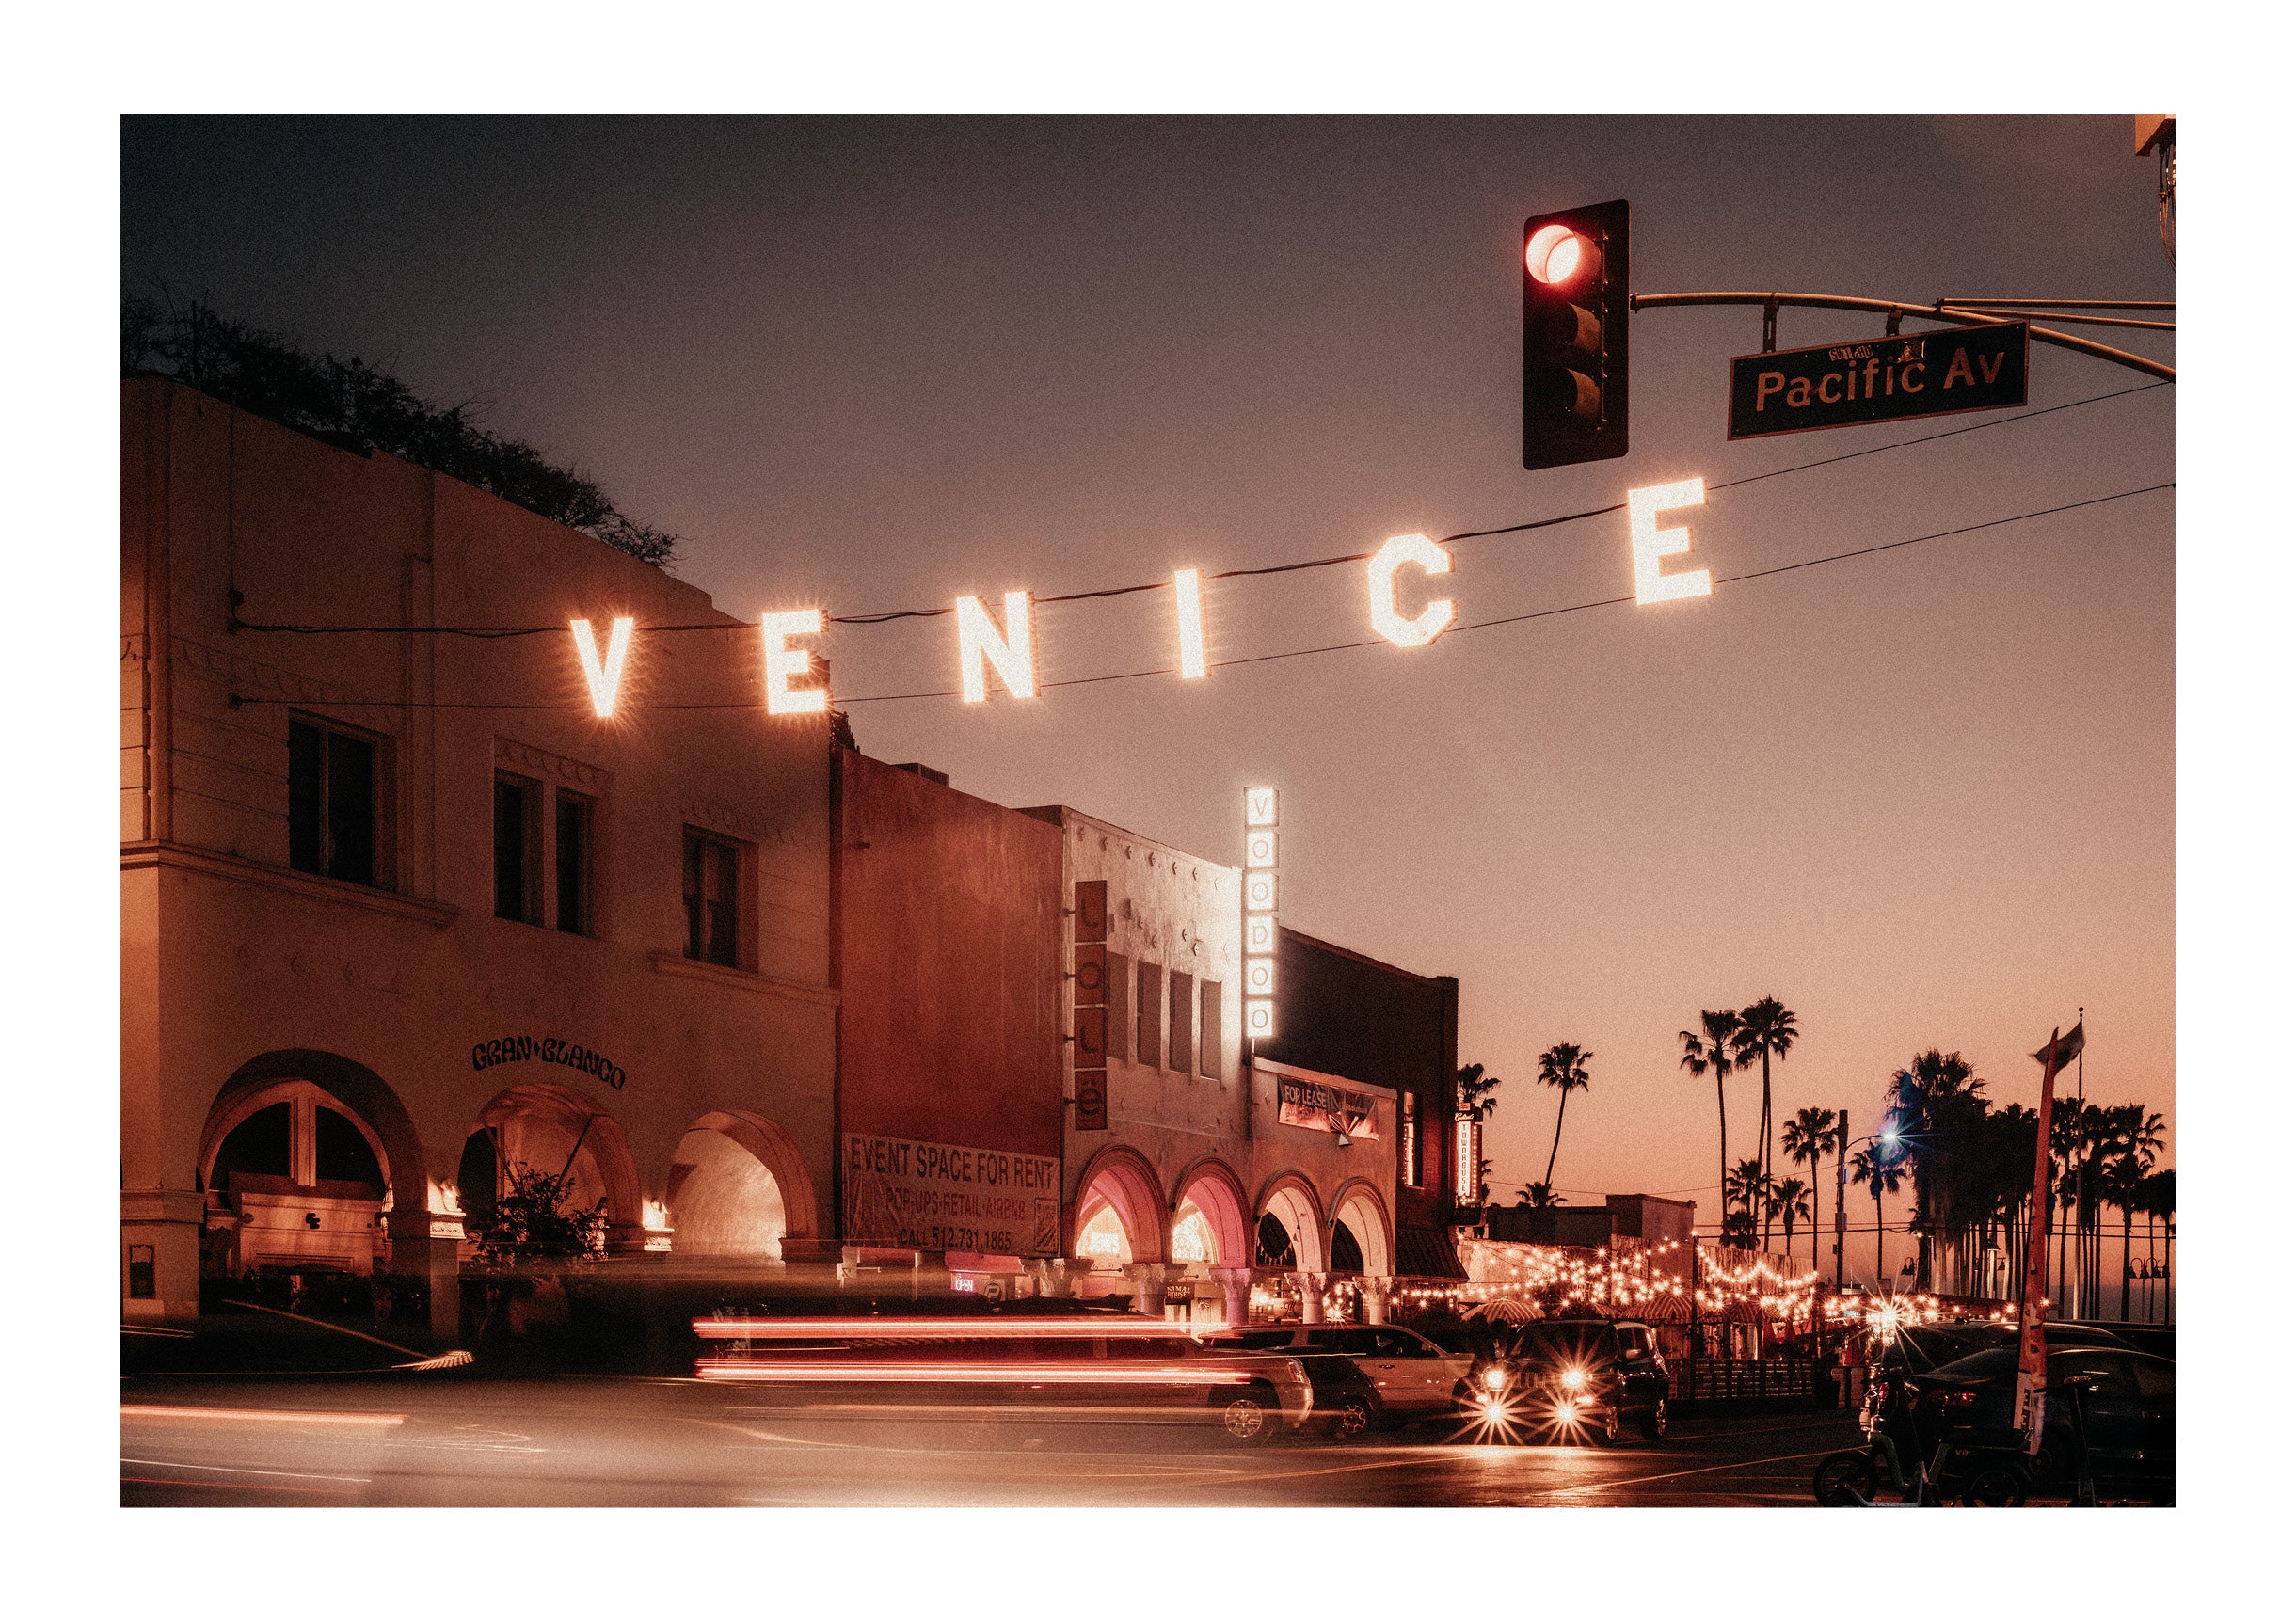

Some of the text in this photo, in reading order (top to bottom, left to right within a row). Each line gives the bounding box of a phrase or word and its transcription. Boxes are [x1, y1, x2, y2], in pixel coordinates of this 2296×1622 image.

[1756, 347, 2004, 412] Pacific Av
[569, 478, 1714, 718] VENICE
[1252, 796, 1269, 1030] VOODOO
[472, 1036, 626, 1091] GRAN BLANCO
[1284, 1085, 1300, 1103] FOR
[1301, 1089, 1327, 1108] LEASE
[851, 1137, 1054, 1189] EVENT SPACE FOR RENT
[900, 1226, 1012, 1251] CALL 512.731.1865
[955, 1279, 974, 1292] OPEN
[1167, 1285, 1190, 1294] NIMAL
